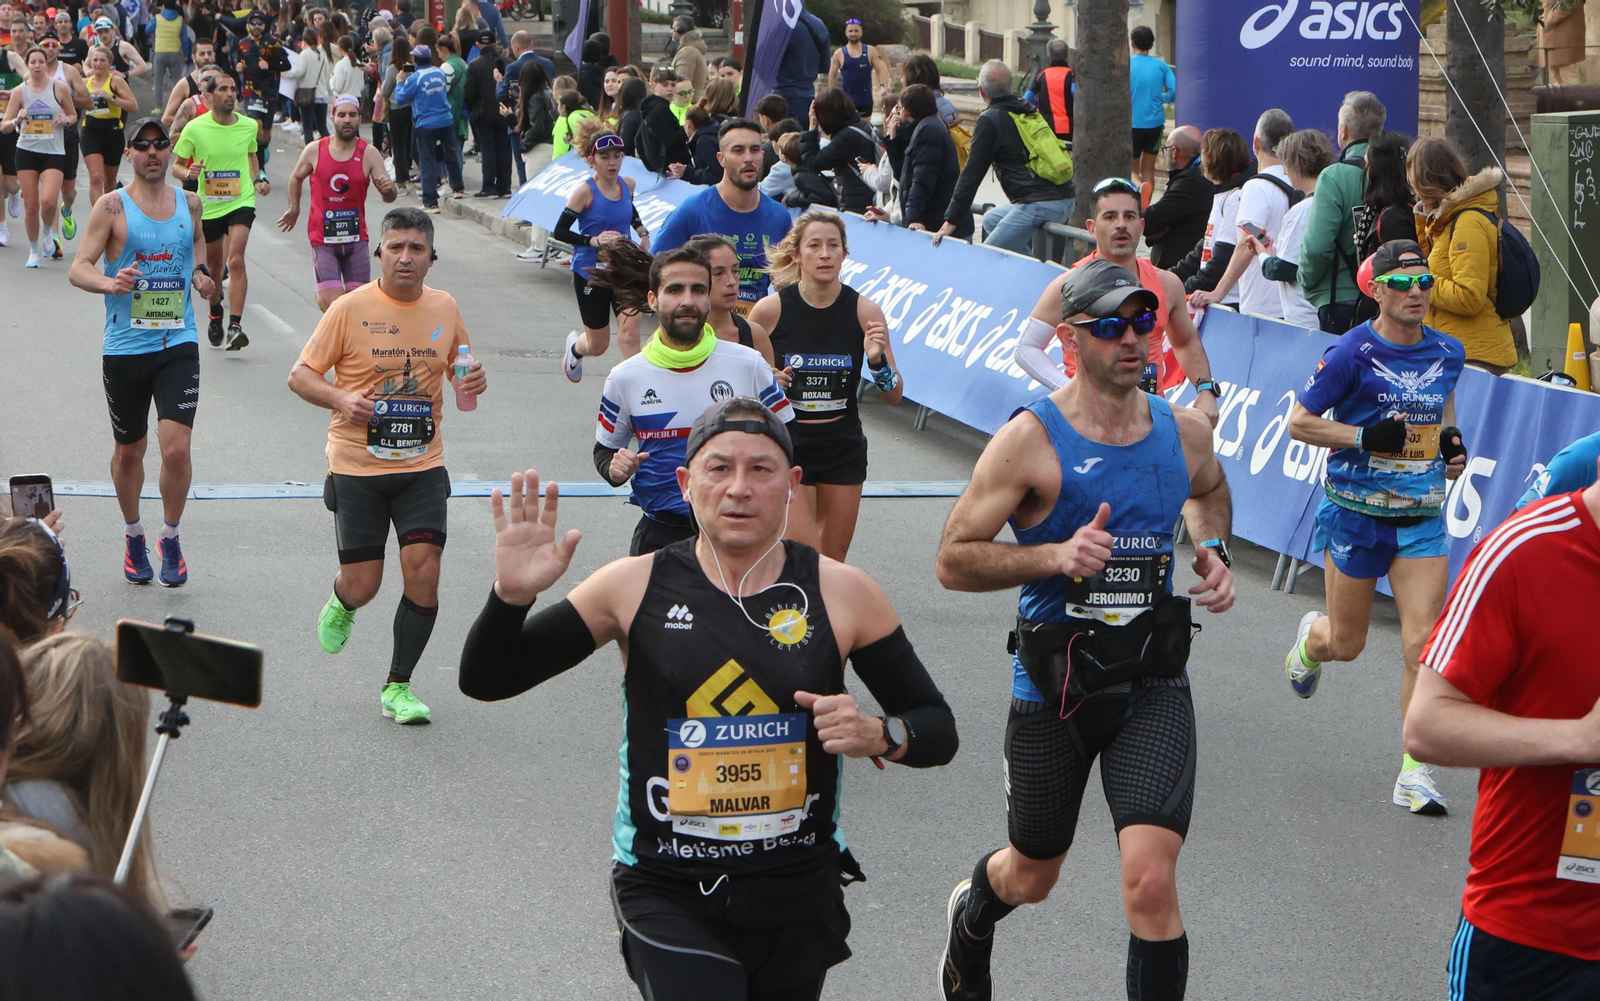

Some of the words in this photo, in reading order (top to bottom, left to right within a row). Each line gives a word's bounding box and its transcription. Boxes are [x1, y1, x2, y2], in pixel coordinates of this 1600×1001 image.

[1299, 1, 1404, 40] asics
[1290, 54, 1332, 67] sound
[1333, 54, 1365, 69] mind,
[1367, 55, 1398, 68] sound
[1398, 55, 1414, 70] body
[152, 281, 180, 289] ZURICH
[737, 291, 757, 300] URICH
[151, 298, 170, 306] 1427
[925, 296, 993, 357] asics
[372, 347, 405, 356] Maratón
[807, 358, 845, 367] ZURICH
[806, 376, 828, 386] 3371
[802, 391, 832, 399] ROXANE
[1403, 393, 1444, 402] RUNNERS
[392, 403, 426, 413] ZURICH
[1389, 402, 1435, 411] ALICANTE
[1404, 413, 1437, 422] ZURICH
[390, 423, 413, 433] 2781
[646, 430, 678, 438] PUEBLA
[1409, 433, 1421, 444] 03
[380, 438, 395, 447] C.L.
[397, 439, 422, 448] BENITO
[1409, 450, 1425, 458] LUIS
[1105, 567, 1141, 583] 3230
[1085, 592, 1145, 605] JERONIMO
[1147, 592, 1153, 604] 1
[664, 622, 693, 630] mobel
[715, 721, 789, 741] ZURICH
[716, 763, 762, 783] 3955
[710, 796, 771, 813] MALVAR
[688, 820, 705, 828] asics
[1575, 864, 1595, 873] asics
